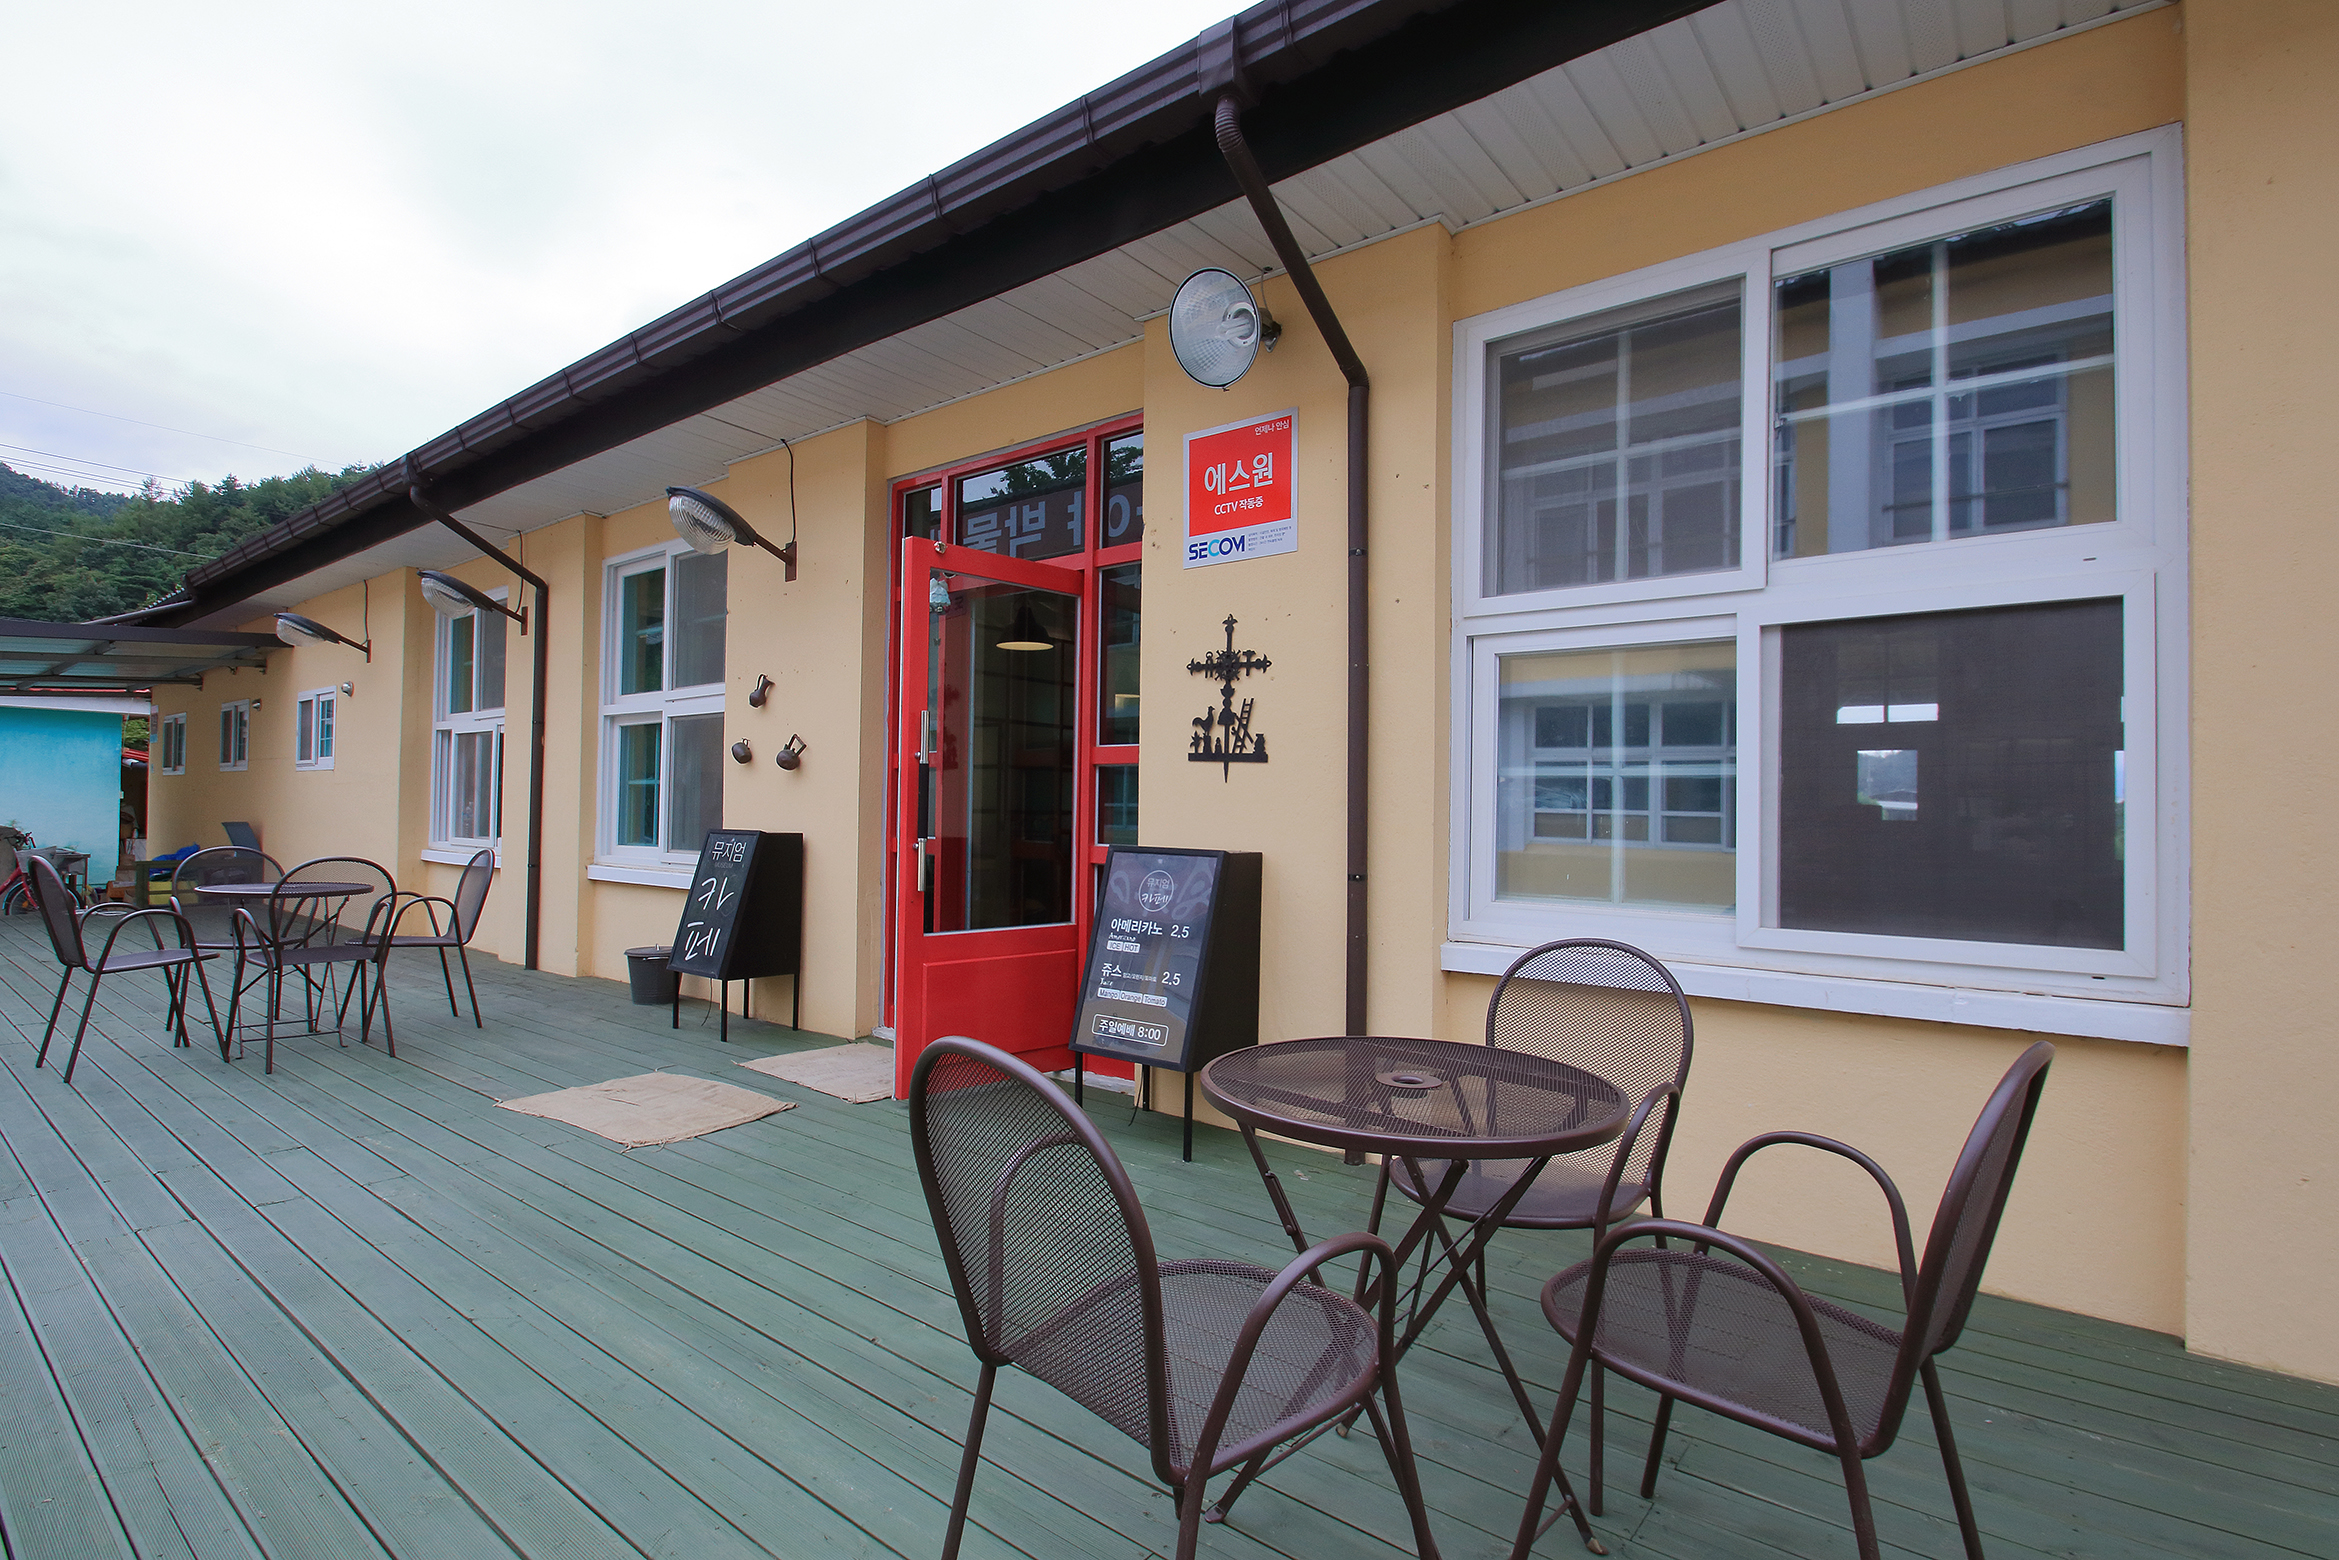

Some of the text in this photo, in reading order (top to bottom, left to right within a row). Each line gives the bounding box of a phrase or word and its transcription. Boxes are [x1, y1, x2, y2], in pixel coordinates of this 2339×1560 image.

[1254, 419, 1290, 436] 언제나 안심
[1204, 452, 1274, 495] 에스원
[1214, 495, 1264, 515] CCTV 작동중
[1188, 534, 1246, 561] SECOM
[712, 841, 747, 863] 뮤지엄
[698, 877, 735, 910] 카
[1147, 877, 1170, 889] 뮤지엄
[1141, 892, 1170, 905] 카페
[1111, 918, 1190, 939] 아메리카노 2.5
[1109, 942, 1138, 951] ICE HOT
[1101, 962, 1122, 977] 쥬스
[1161, 971, 1181, 986] 2.5
[1099, 989, 1166, 1006] Mango Orange Tomato
[1098, 1019, 1161, 1041] 주일예배 8:00
